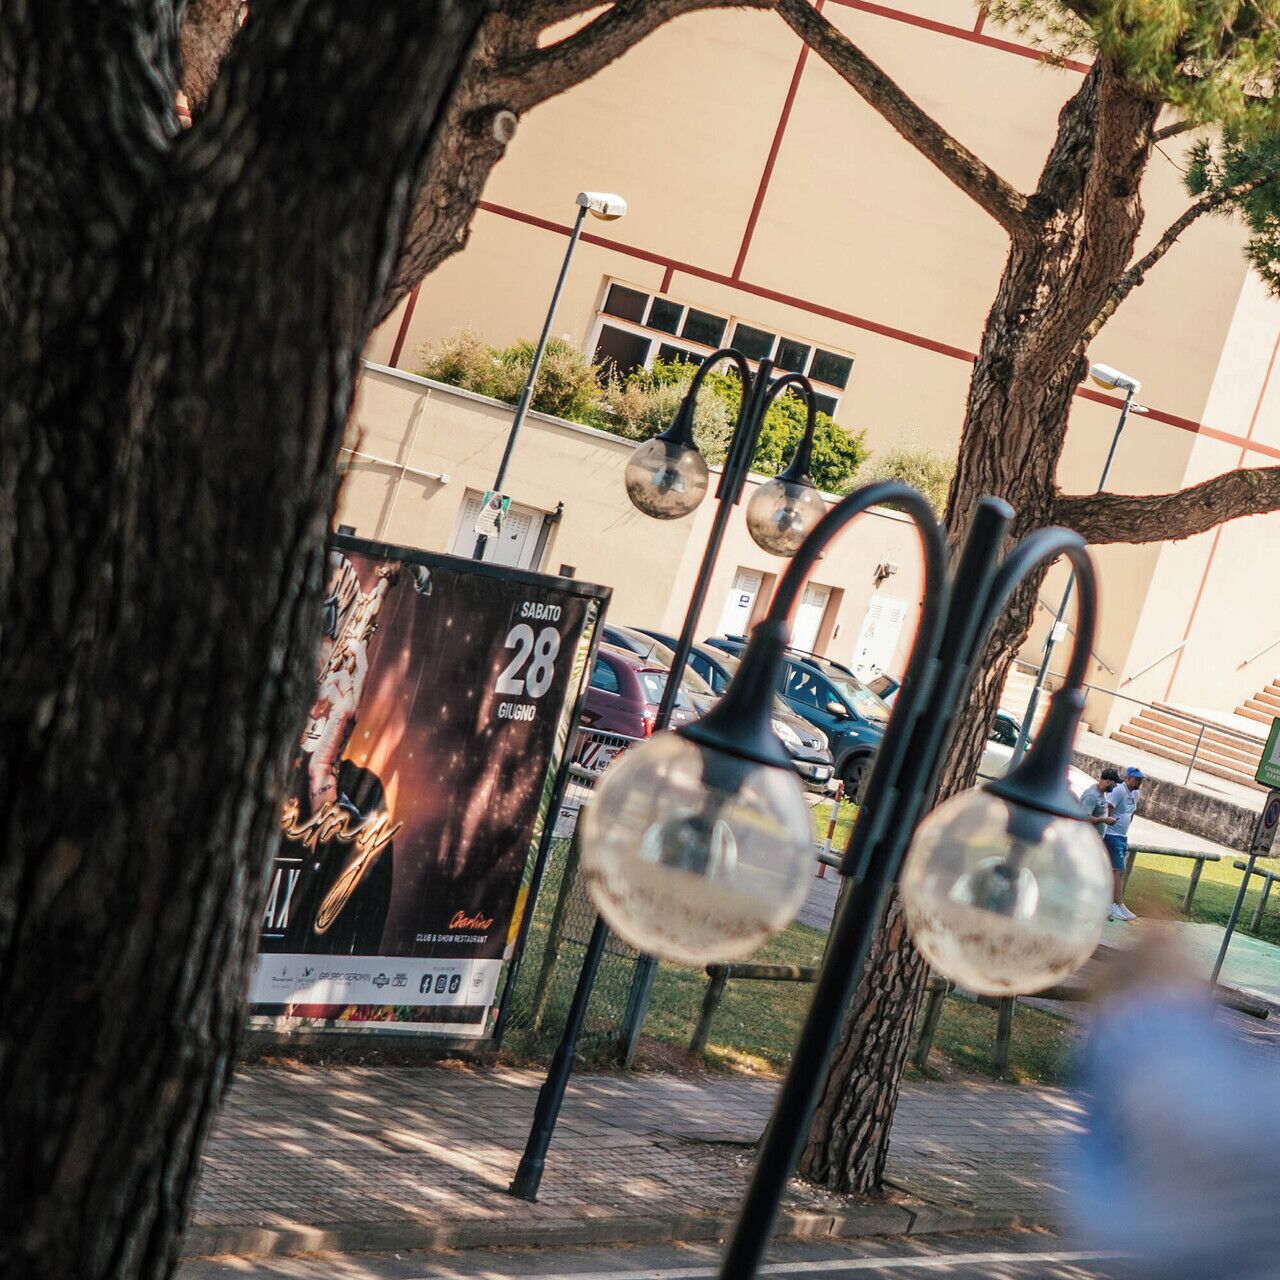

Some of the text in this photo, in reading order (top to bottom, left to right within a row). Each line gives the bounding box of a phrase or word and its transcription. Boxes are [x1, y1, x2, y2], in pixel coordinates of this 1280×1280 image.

[521, 601, 562, 622] SABATO
[495, 623, 561, 698] 28
[498, 703, 537, 722] GIUGNO
[261, 868, 301, 929] AX
[416, 933, 488, 944] CLUB & SHOW RESTAURANT
